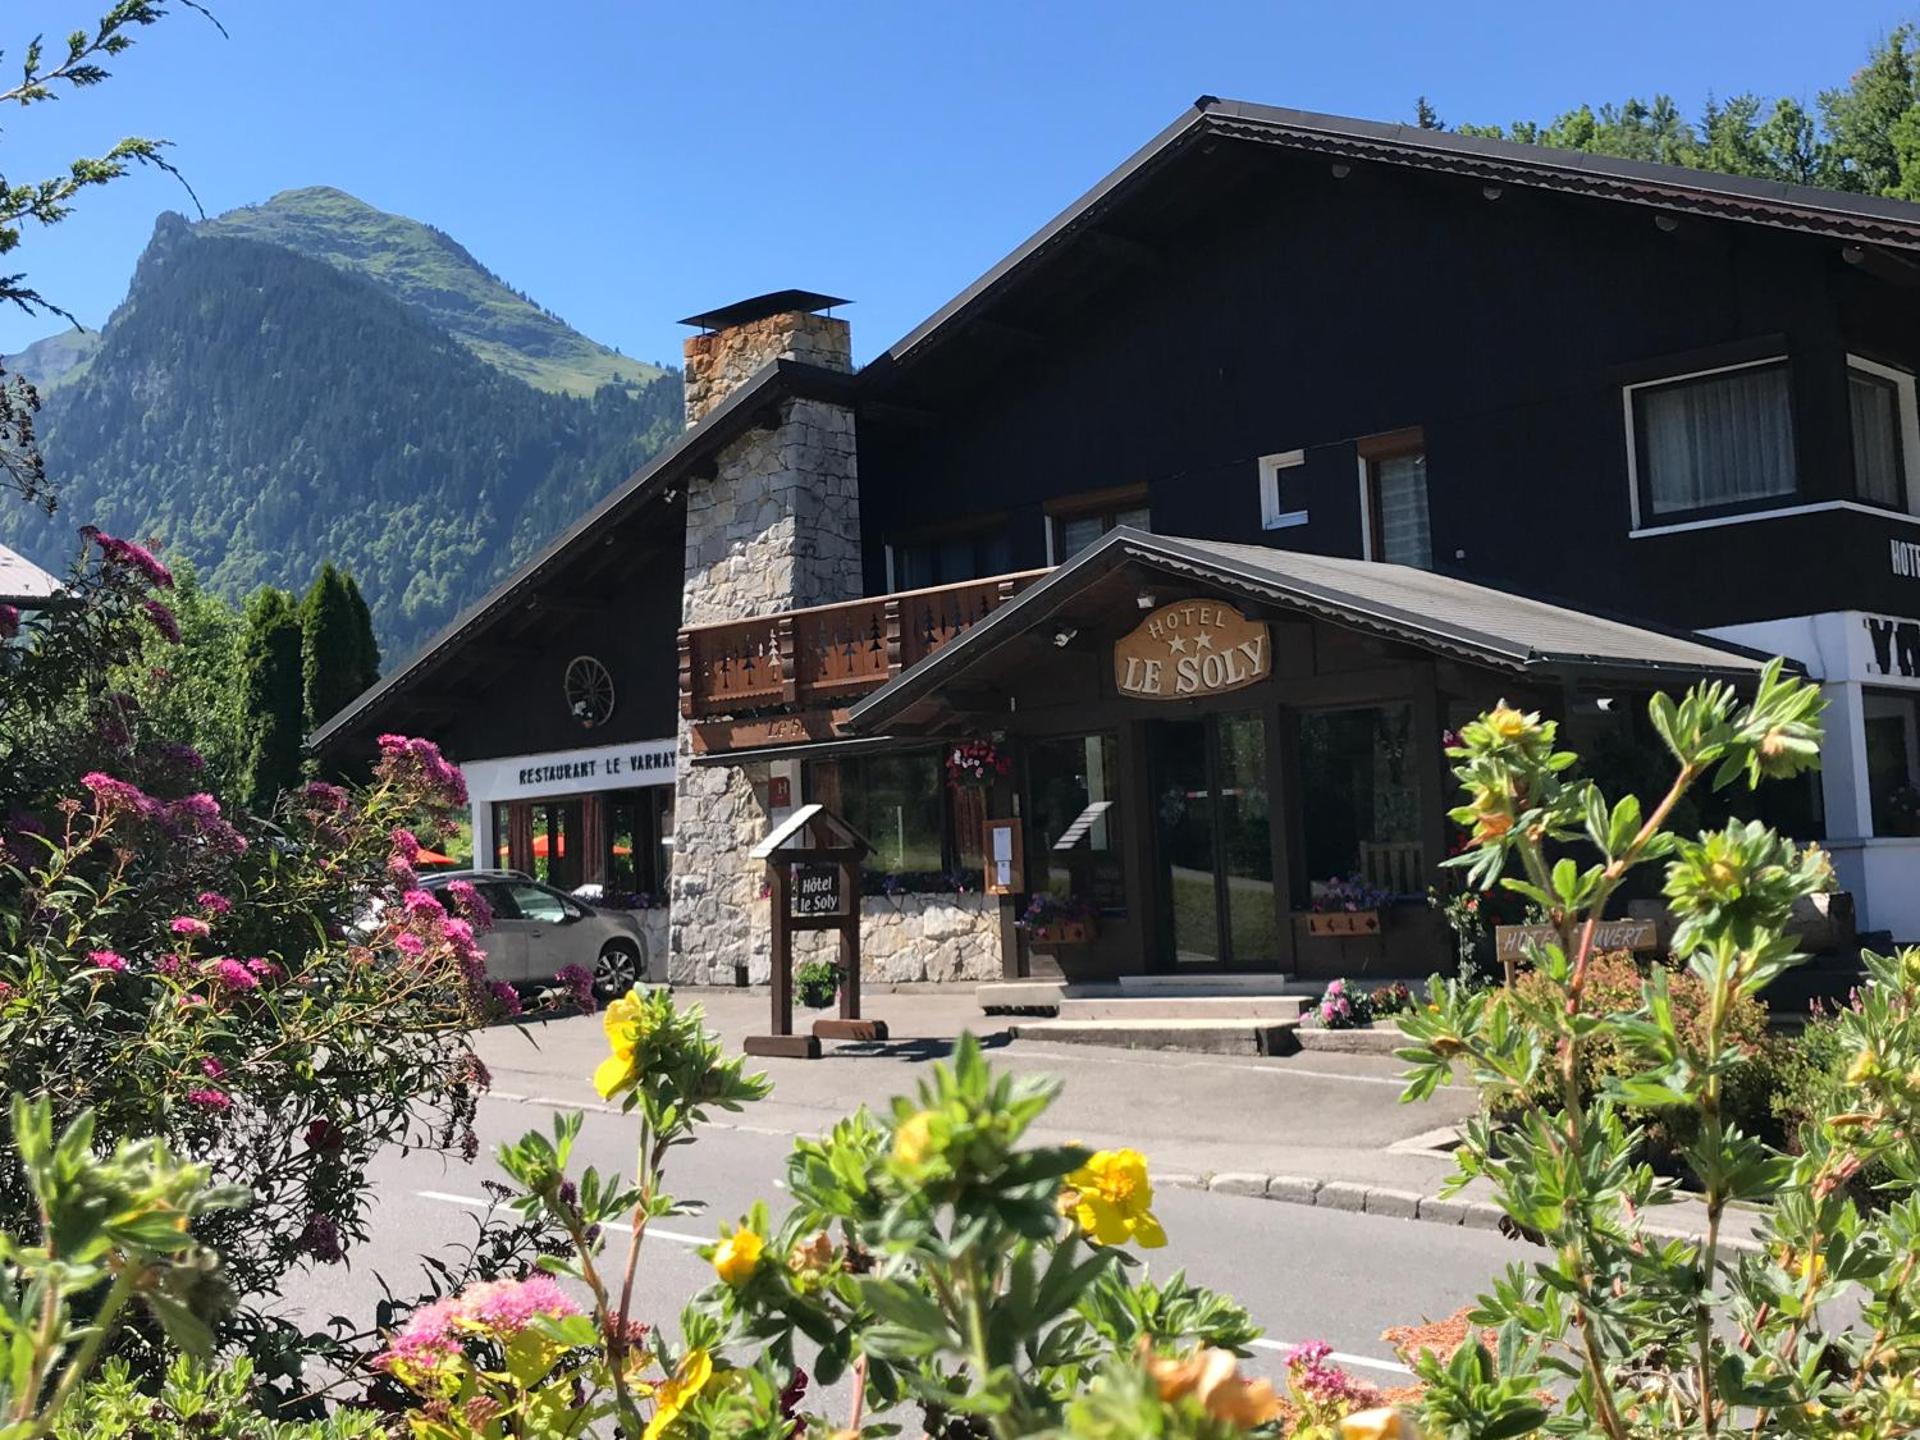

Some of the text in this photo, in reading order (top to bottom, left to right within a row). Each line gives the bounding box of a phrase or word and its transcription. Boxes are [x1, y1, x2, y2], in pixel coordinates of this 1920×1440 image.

[1149, 607, 1225, 639] HOTEL
[1123, 635, 1266, 694] LE SOLY
[519, 751, 676, 785] RESTAURANT LE VARNAY
[802, 876, 832, 894] Hôtel
[800, 894, 838, 912] le Soly
